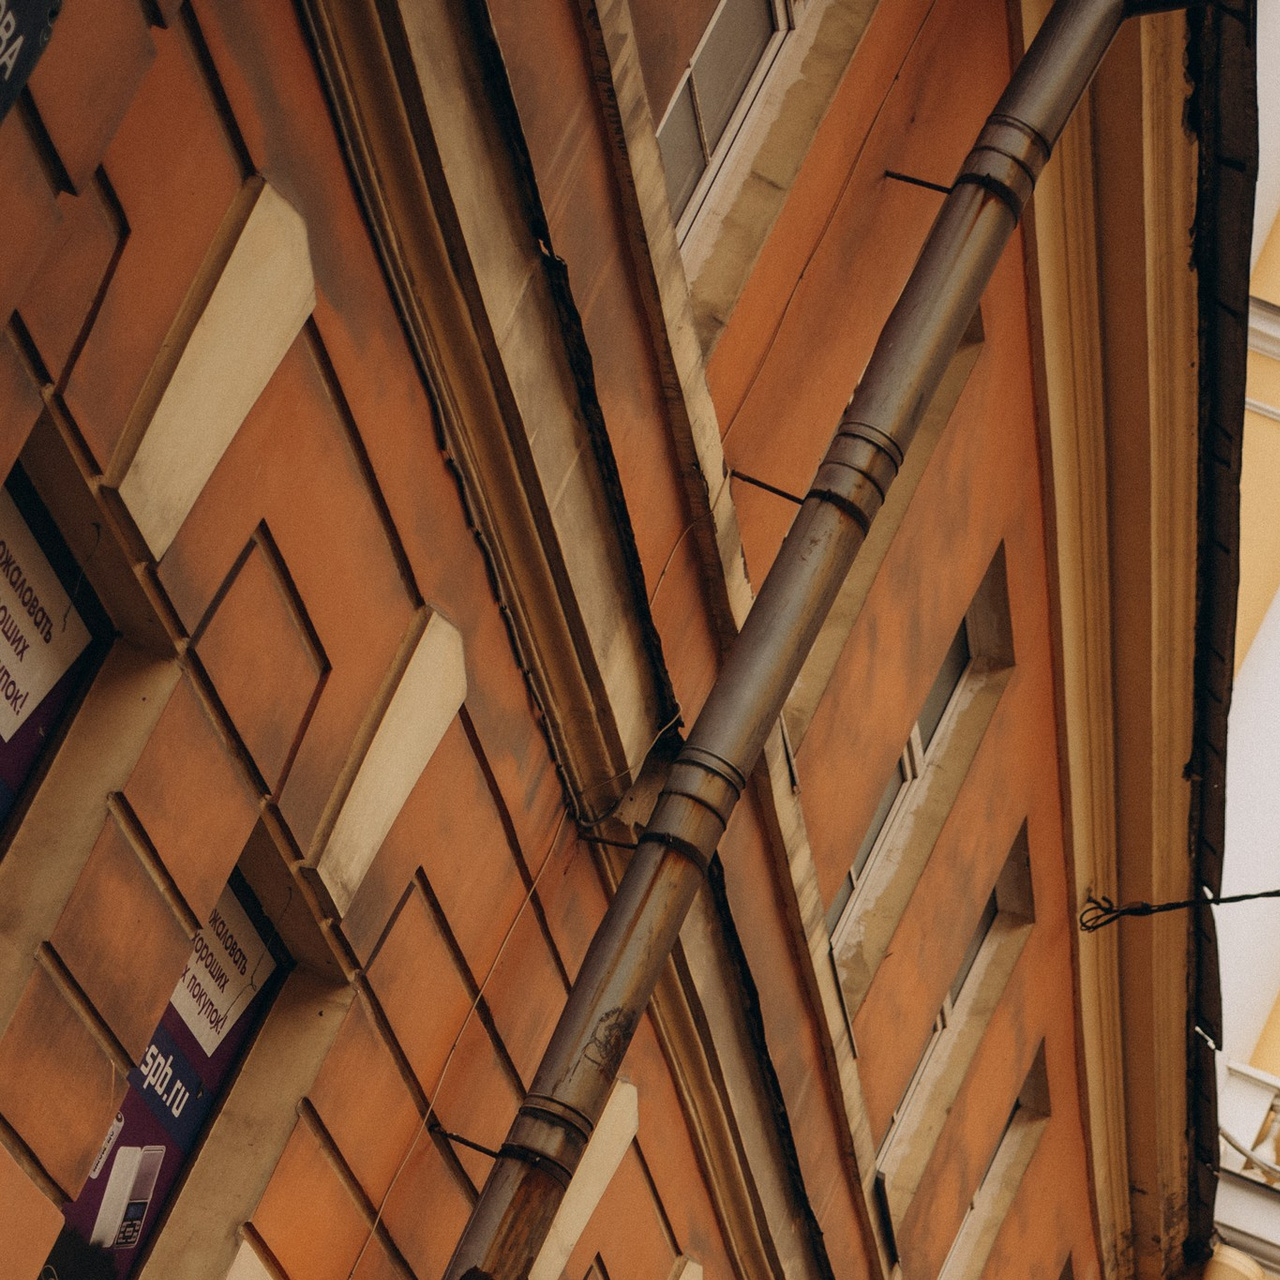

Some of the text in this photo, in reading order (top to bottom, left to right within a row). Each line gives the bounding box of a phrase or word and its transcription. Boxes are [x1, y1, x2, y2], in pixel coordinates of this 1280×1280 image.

[0, 662, 29, 716] пок!
[209, 908, 249, 976] жаловать
[186, 974, 229, 1035] покупок!
